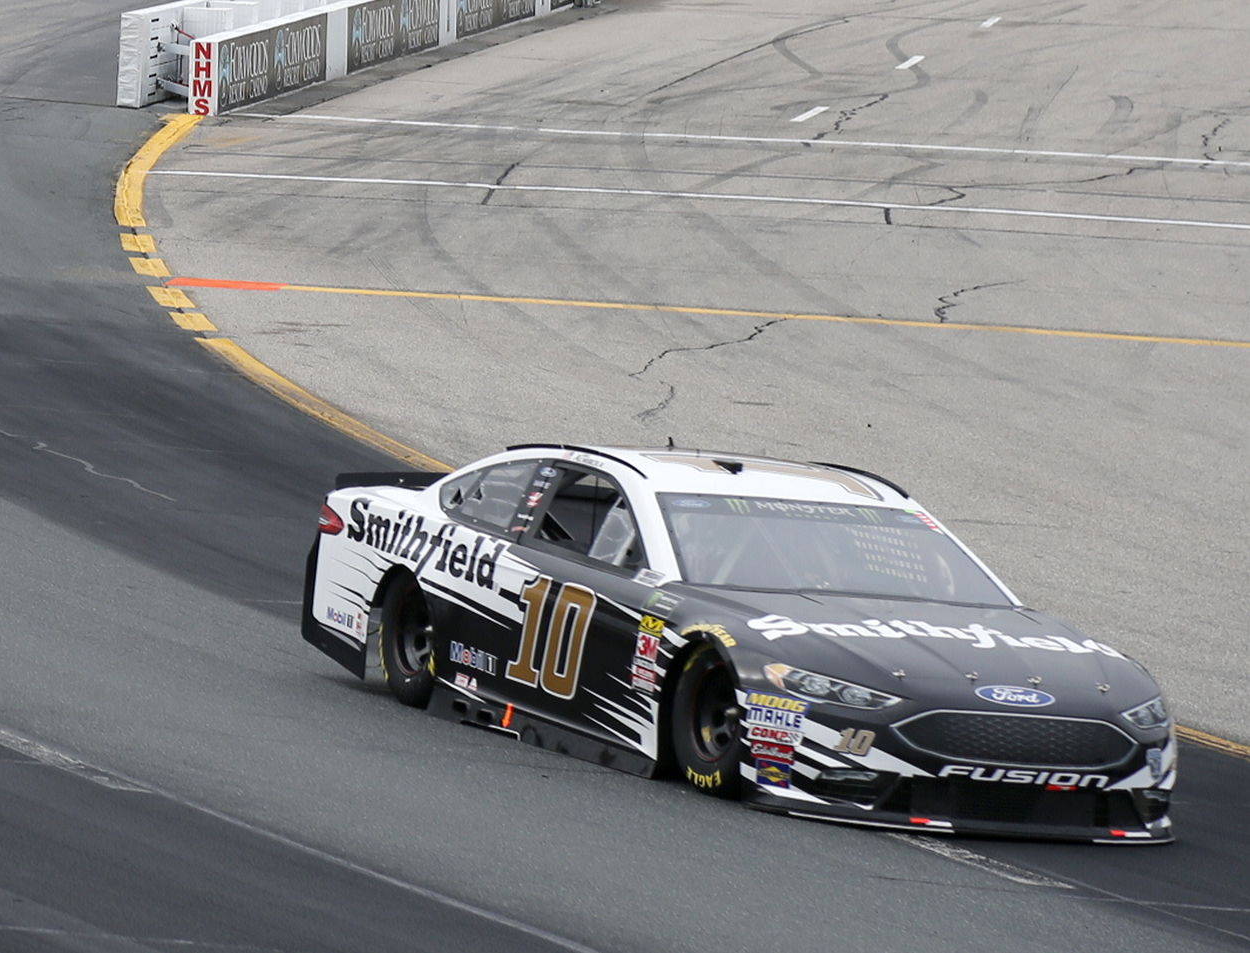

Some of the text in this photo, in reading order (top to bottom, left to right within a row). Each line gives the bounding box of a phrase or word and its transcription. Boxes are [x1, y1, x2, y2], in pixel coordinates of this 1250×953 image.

[230, 39, 269, 82] FOXWOODS
[193, 42, 212, 116] NHMS
[754, 500, 856, 517] MONSTER
[347, 497, 507, 590] Smithfield
[327, 606, 347, 626] Mobil
[505, 573, 597, 700] 10
[637, 635, 659, 662] 3M
[747, 613, 1130, 661] Smithfield
[450, 640, 498, 676] Mobil 1
[748, 692, 806, 713] MOOG
[992, 687, 1040, 704] Ford
[750, 706, 803, 729] MAHLE
[751, 726, 789, 740] COMP
[833, 727, 876, 757] 10
[687, 765, 722, 789] EAGLE
[937, 764, 1110, 788] FUSION
